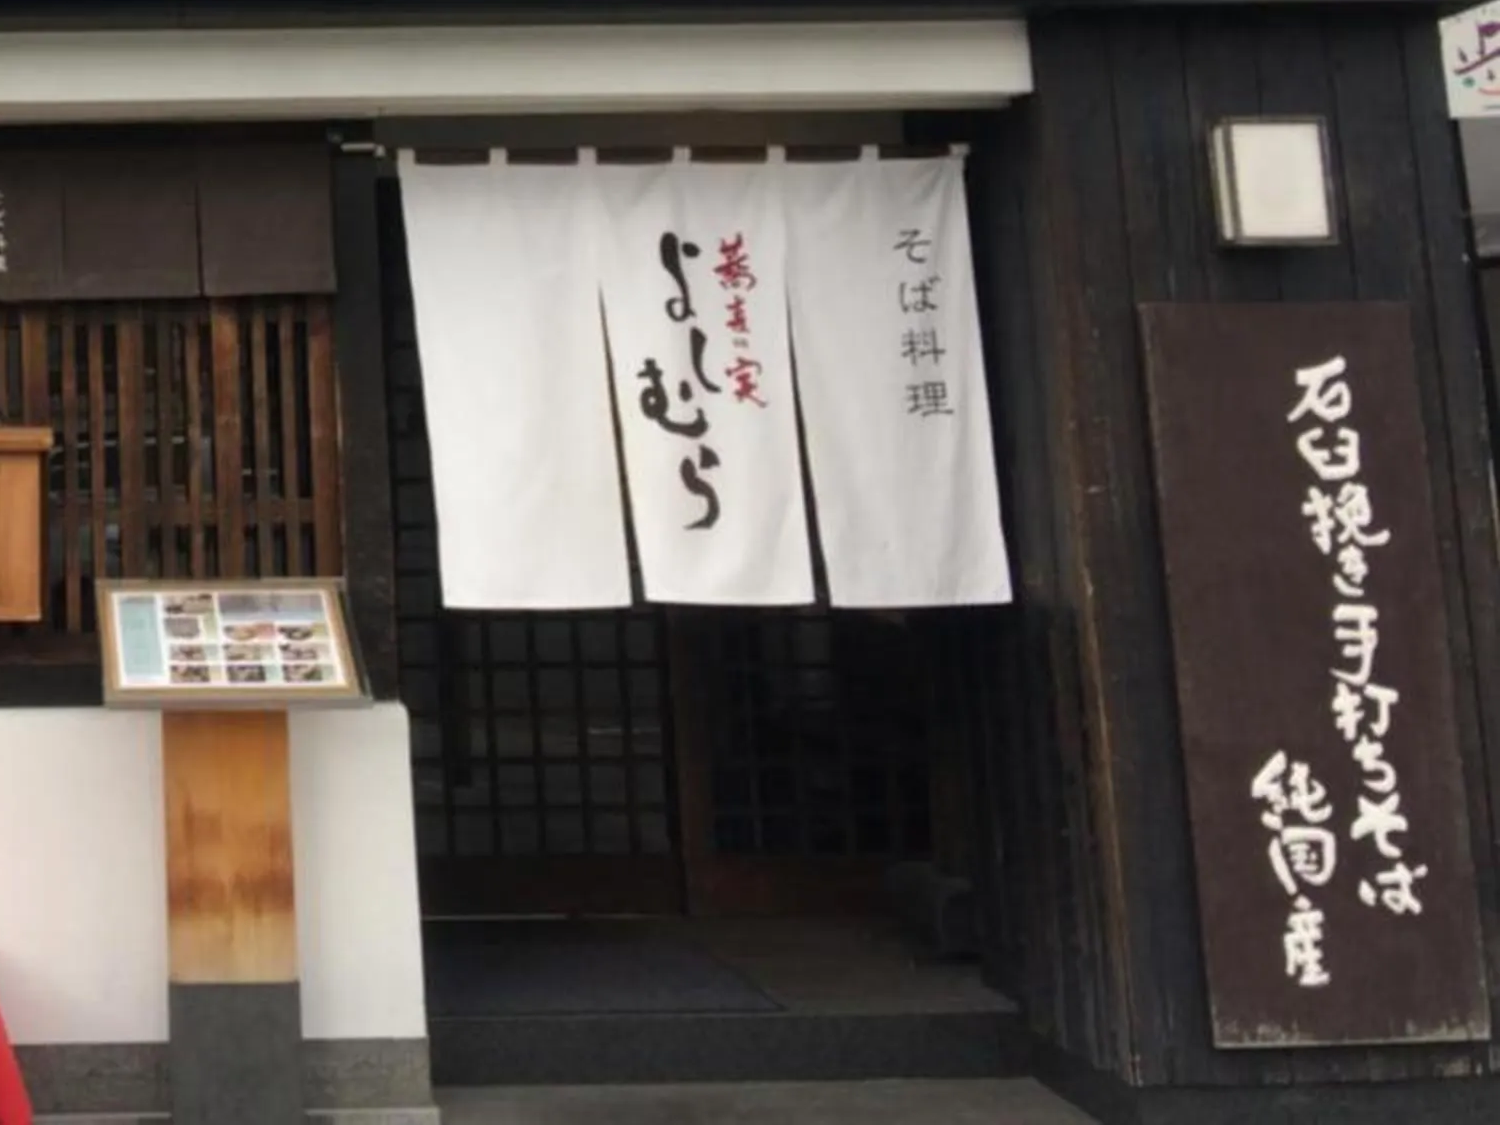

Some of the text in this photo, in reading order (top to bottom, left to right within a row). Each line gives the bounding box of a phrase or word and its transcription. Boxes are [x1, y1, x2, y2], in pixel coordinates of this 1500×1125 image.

[637, 232, 721, 530] よしむら
[893, 227, 954, 418] そば料理
[1287, 355, 1429, 916] 石臼挽き手打ちそば
[1250, 750, 1334, 988] 純国産
